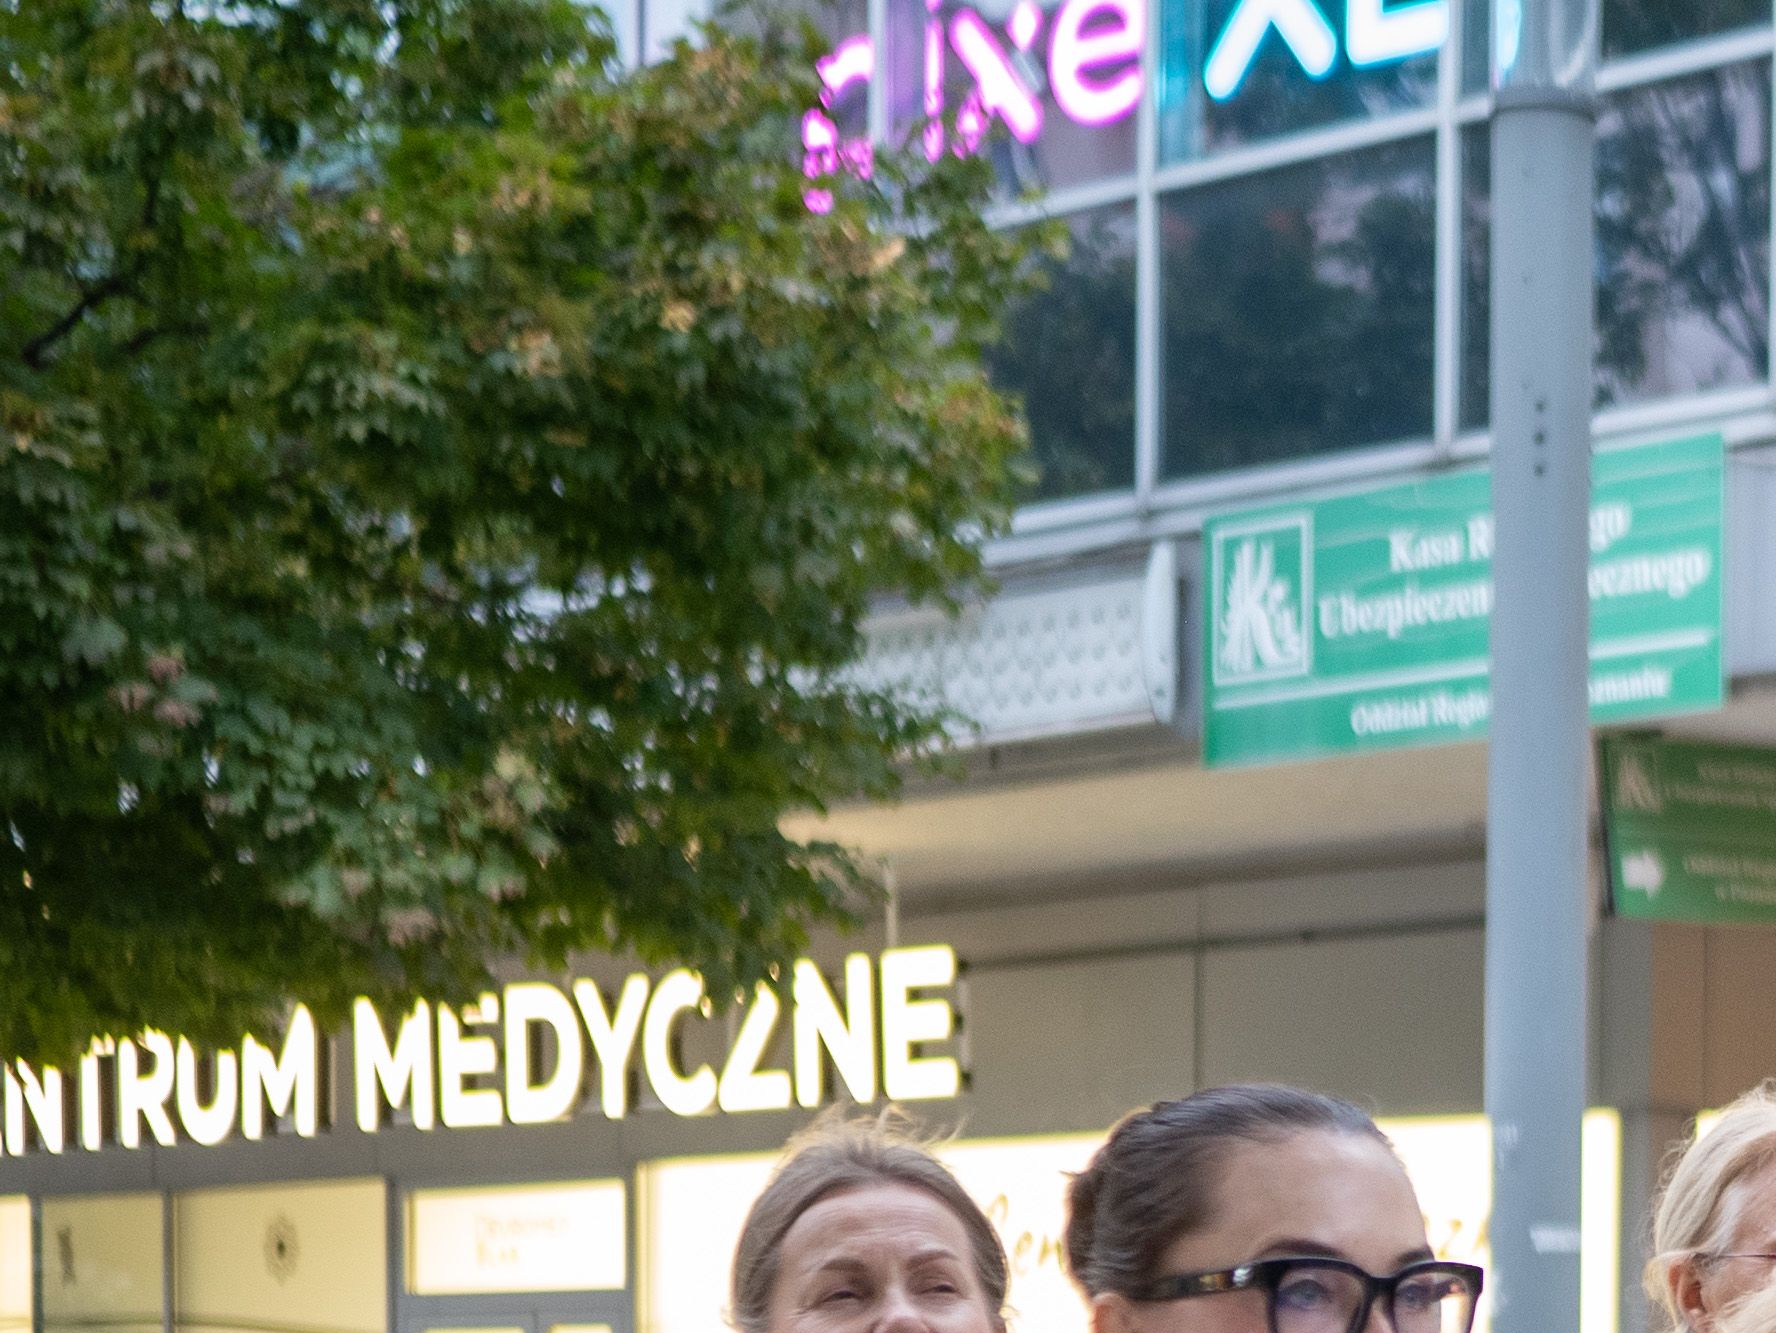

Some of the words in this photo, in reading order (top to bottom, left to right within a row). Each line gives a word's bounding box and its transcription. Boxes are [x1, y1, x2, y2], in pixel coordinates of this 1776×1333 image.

[1317, 580, 1491, 639] Ubezpieczen
[1587, 549, 1712, 600] ecznego
[1388, 530, 1461, 571] Kasa
[0, 1001, 316, 1158] NTRUM
[353, 944, 959, 1132] MEDYCZNE
